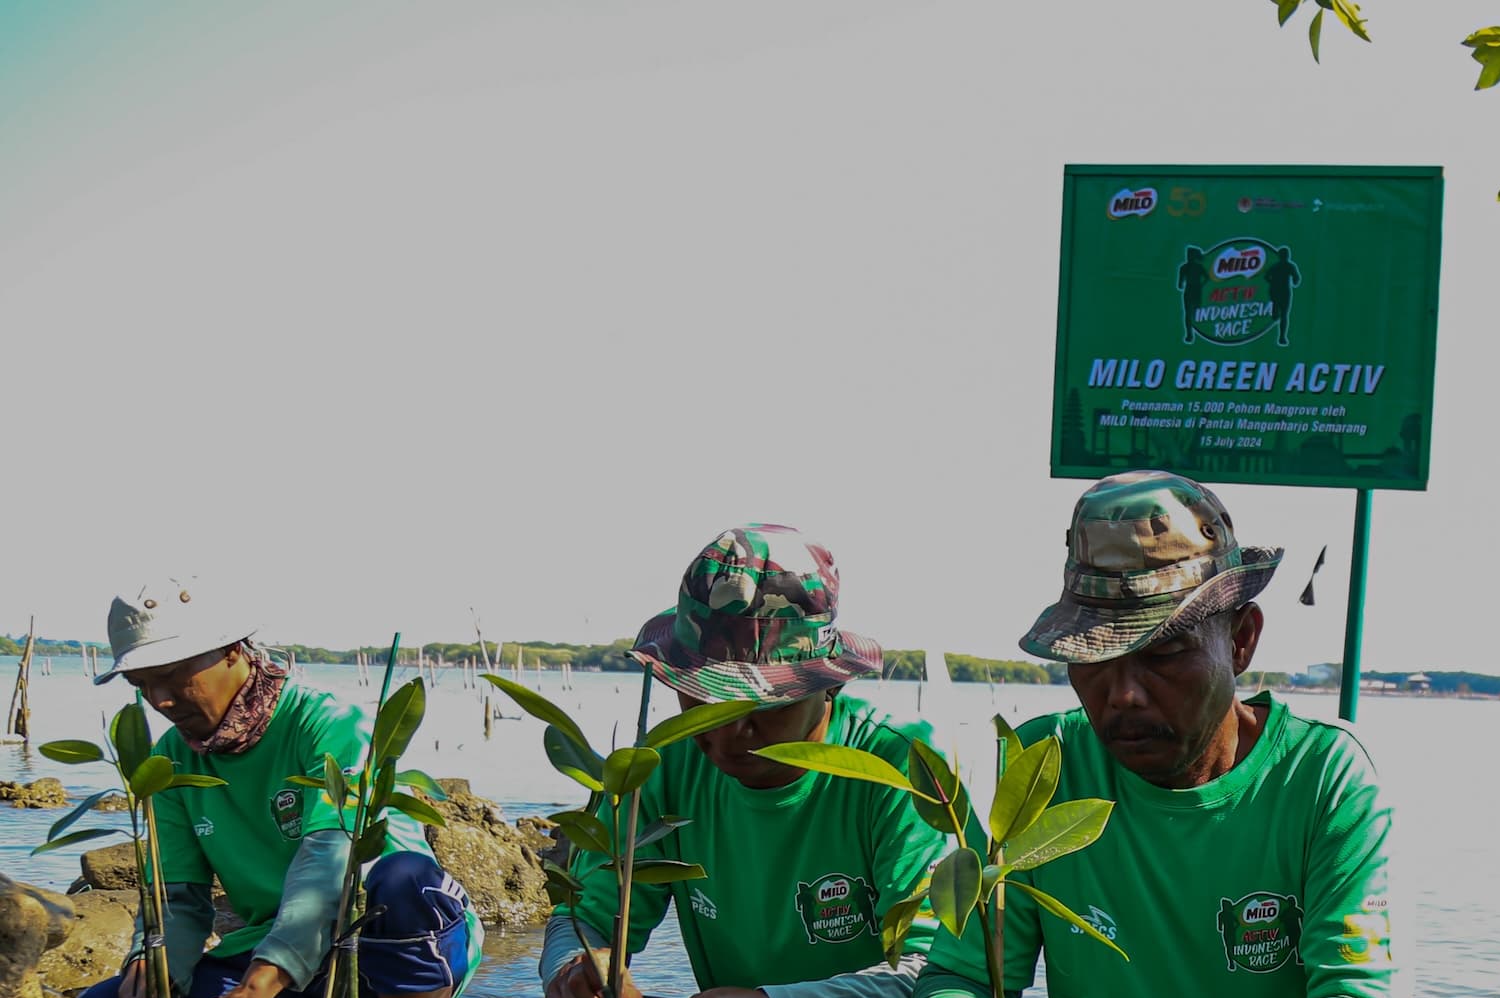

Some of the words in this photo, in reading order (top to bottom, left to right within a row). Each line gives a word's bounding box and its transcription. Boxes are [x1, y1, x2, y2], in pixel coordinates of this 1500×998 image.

[1113, 197, 1152, 212] MILO
[1217, 256, 1261, 273] MILO
[1195, 301, 1274, 322] INDONESIA
[1215, 319, 1252, 338] RACE
[1087, 358, 1165, 389] MILO
[1175, 360, 1278, 391] GREEN
[1285, 363, 1385, 394] ACTIV
[1121, 399, 1184, 412] Penanaman
[1187, 401, 1225, 413] 15.000
[1227, 402, 1261, 414] Pohon
[1264, 403, 1318, 418] Mangrove
[1321, 405, 1346, 417] oleh
[1100, 414, 1127, 427] MILO
[1130, 415, 1181, 428] Indonesia
[1185, 417, 1195, 428] di
[1198, 417, 1233, 430] Pantai
[1237, 418, 1309, 434] Mangunharjo
[1311, 420, 1367, 435] Semarang
[1200, 435, 1212, 447] 15
[1214, 435, 1235, 449] July
[1237, 436, 1262, 448] 2024
[820, 886, 847, 899] MILO
[691, 901, 717, 920] PECS
[1246, 907, 1277, 920] MILO
[813, 912, 864, 930] INDONESIA
[1233, 936, 1290, 956] INDONESIA
[1248, 953, 1278, 967] RACE
